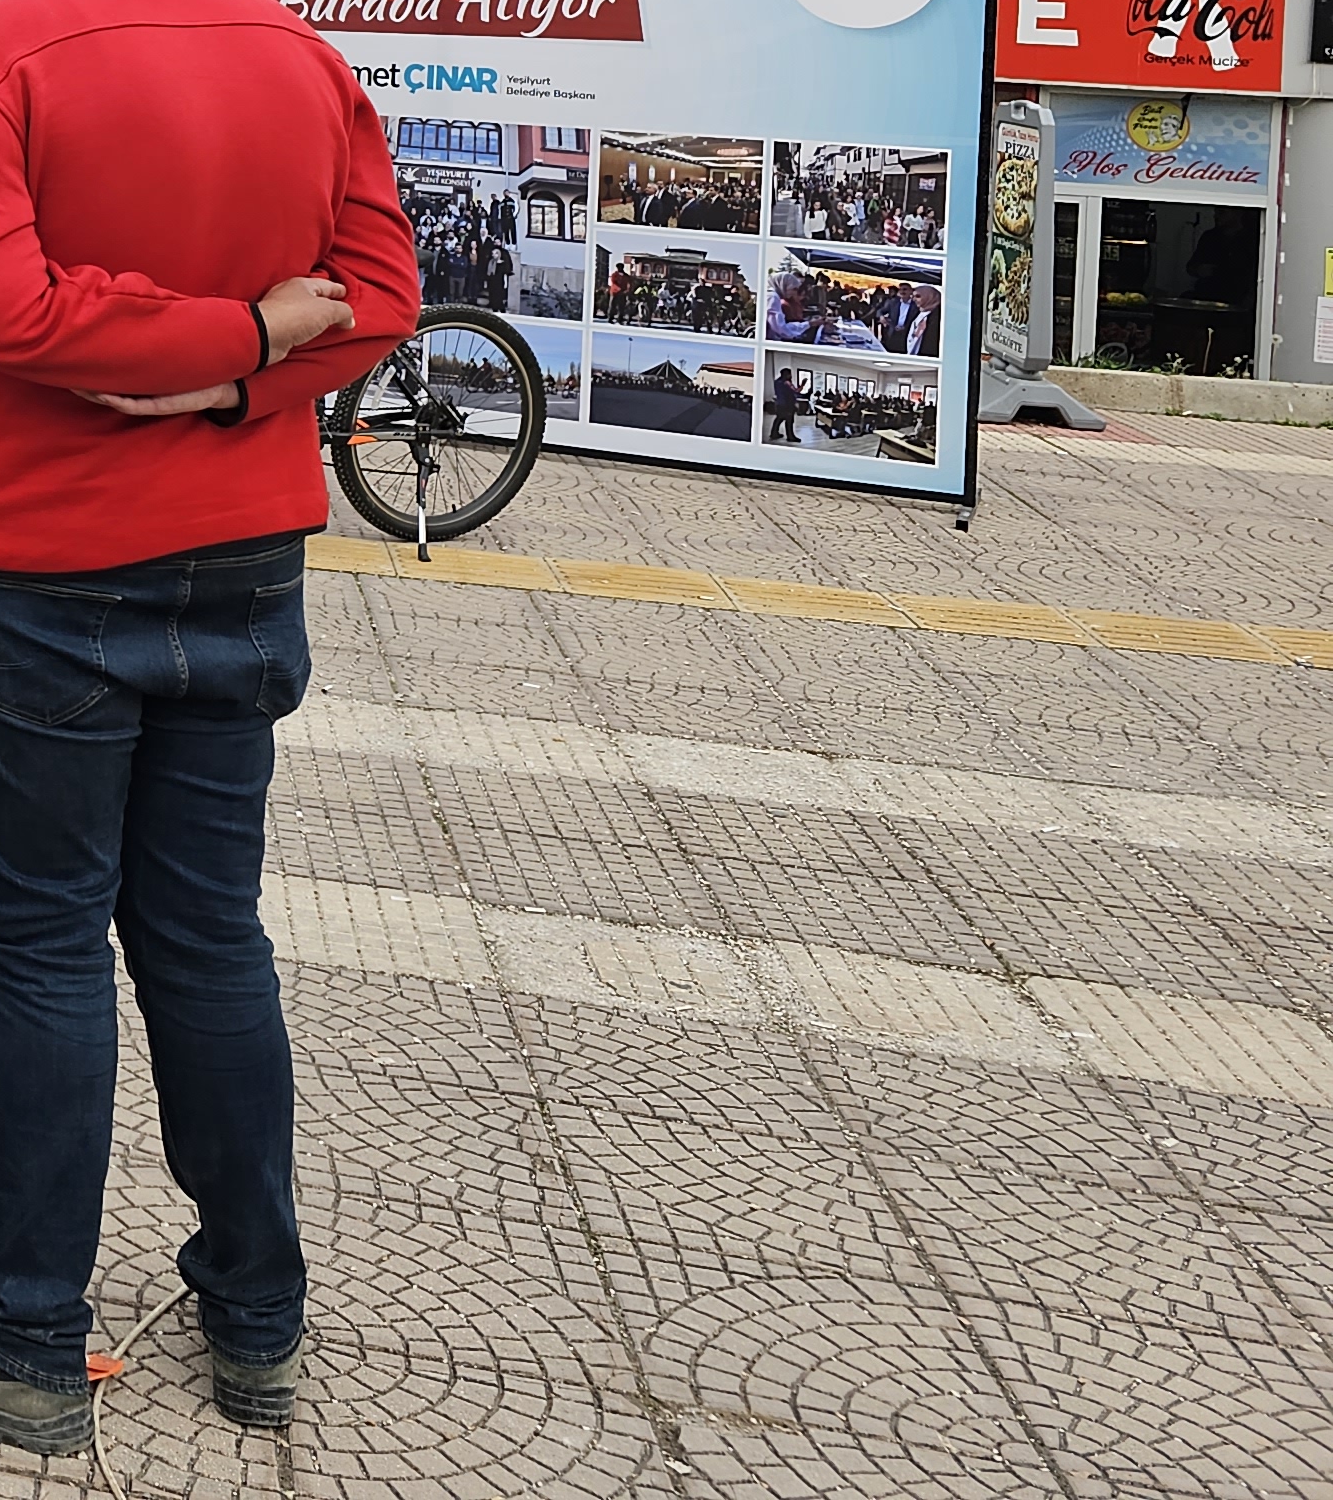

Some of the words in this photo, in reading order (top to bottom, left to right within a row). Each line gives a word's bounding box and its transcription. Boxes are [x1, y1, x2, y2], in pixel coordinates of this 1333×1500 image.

[1143, 52, 1195, 67] Gerçek
[403, 63, 498, 94] ÇINAR
[506, 74, 551, 87] Yeşilyurt
[506, 86, 551, 98] Belediye
[553, 89, 596, 100] Başkanı
[1005, 139, 1036, 161] PİZZA
[1063, 150, 1129, 179] Hoş
[1134, 152, 1262, 184] Geldiniz
